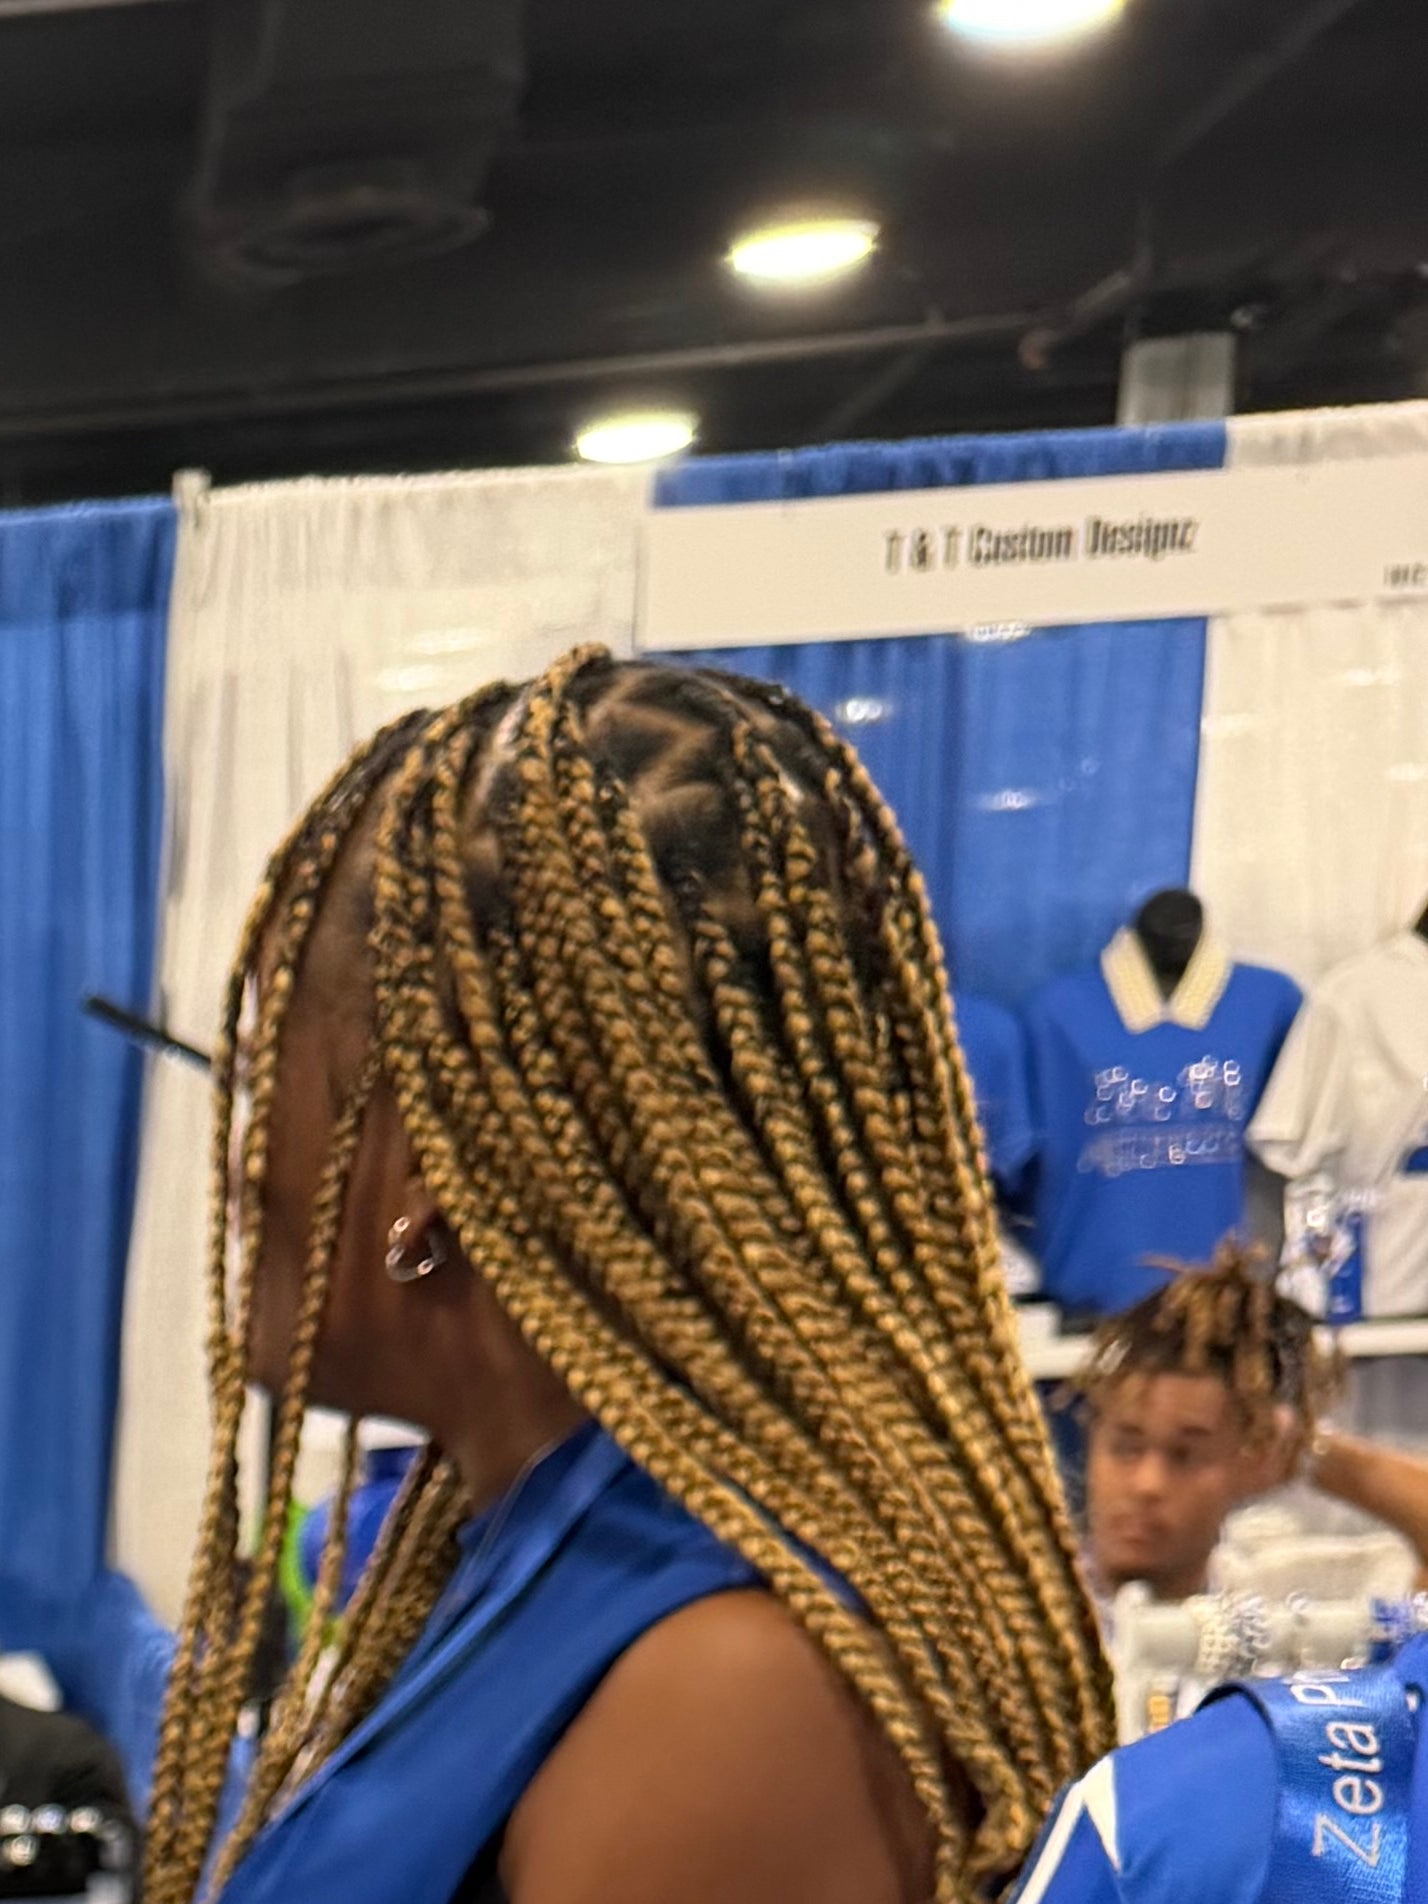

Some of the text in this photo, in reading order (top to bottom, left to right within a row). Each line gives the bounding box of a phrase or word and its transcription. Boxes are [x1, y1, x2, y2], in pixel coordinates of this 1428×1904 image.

[886, 529, 903, 571] T
[911, 529, 931, 569] &
[942, 525, 962, 569] T
[970, 522, 1073, 566] Custom
[1310, 1718, 1384, 1868] Zeta
